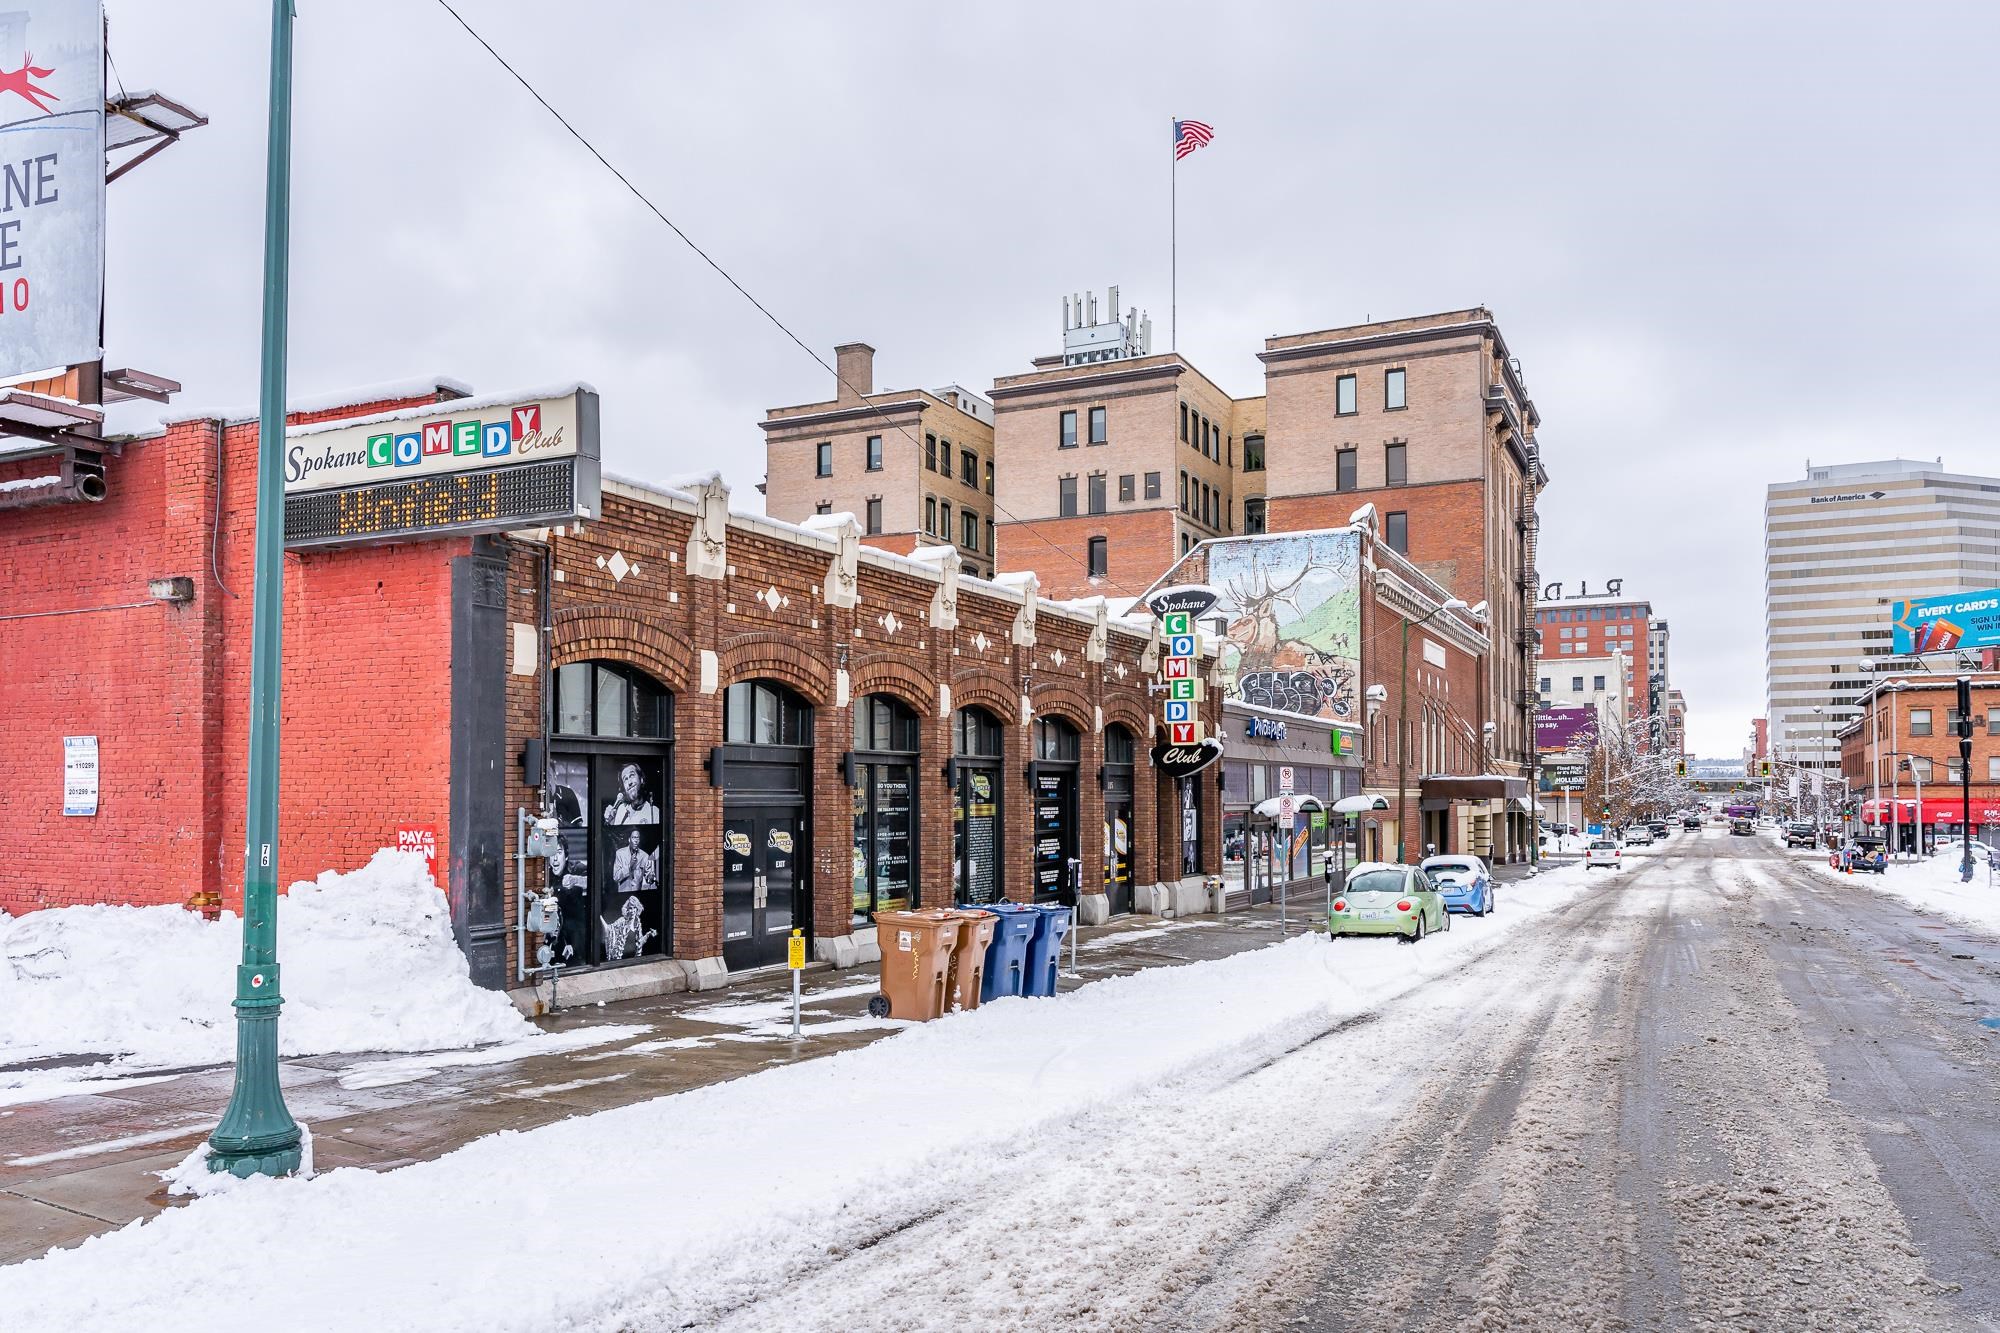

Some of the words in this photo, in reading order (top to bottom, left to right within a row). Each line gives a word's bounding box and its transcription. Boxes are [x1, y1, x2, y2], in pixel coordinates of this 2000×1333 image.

[0, 152, 58, 213] NE
[285, 446, 367, 483] Spokane
[369, 407, 539, 466] COMEDY
[518, 426, 564, 454] Club
[1811, 496, 1829, 504] Bank
[1837, 493, 1866, 501] America
[1158, 595, 1206, 612] Spokane
[1918, 604, 1953, 618] EVERY
[1955, 598, 1999, 613] CARD'S
[1970, 616, 1990, 625] SIGN
[1977, 623, 1993, 631] WIN
[1167, 614, 1193, 743] COMEDY
[1163, 748, 1202, 764] Club
[398, 830, 424, 845] PAY
[732, 863, 743, 872] EXIT
[775, 860, 786, 869] EXIT
